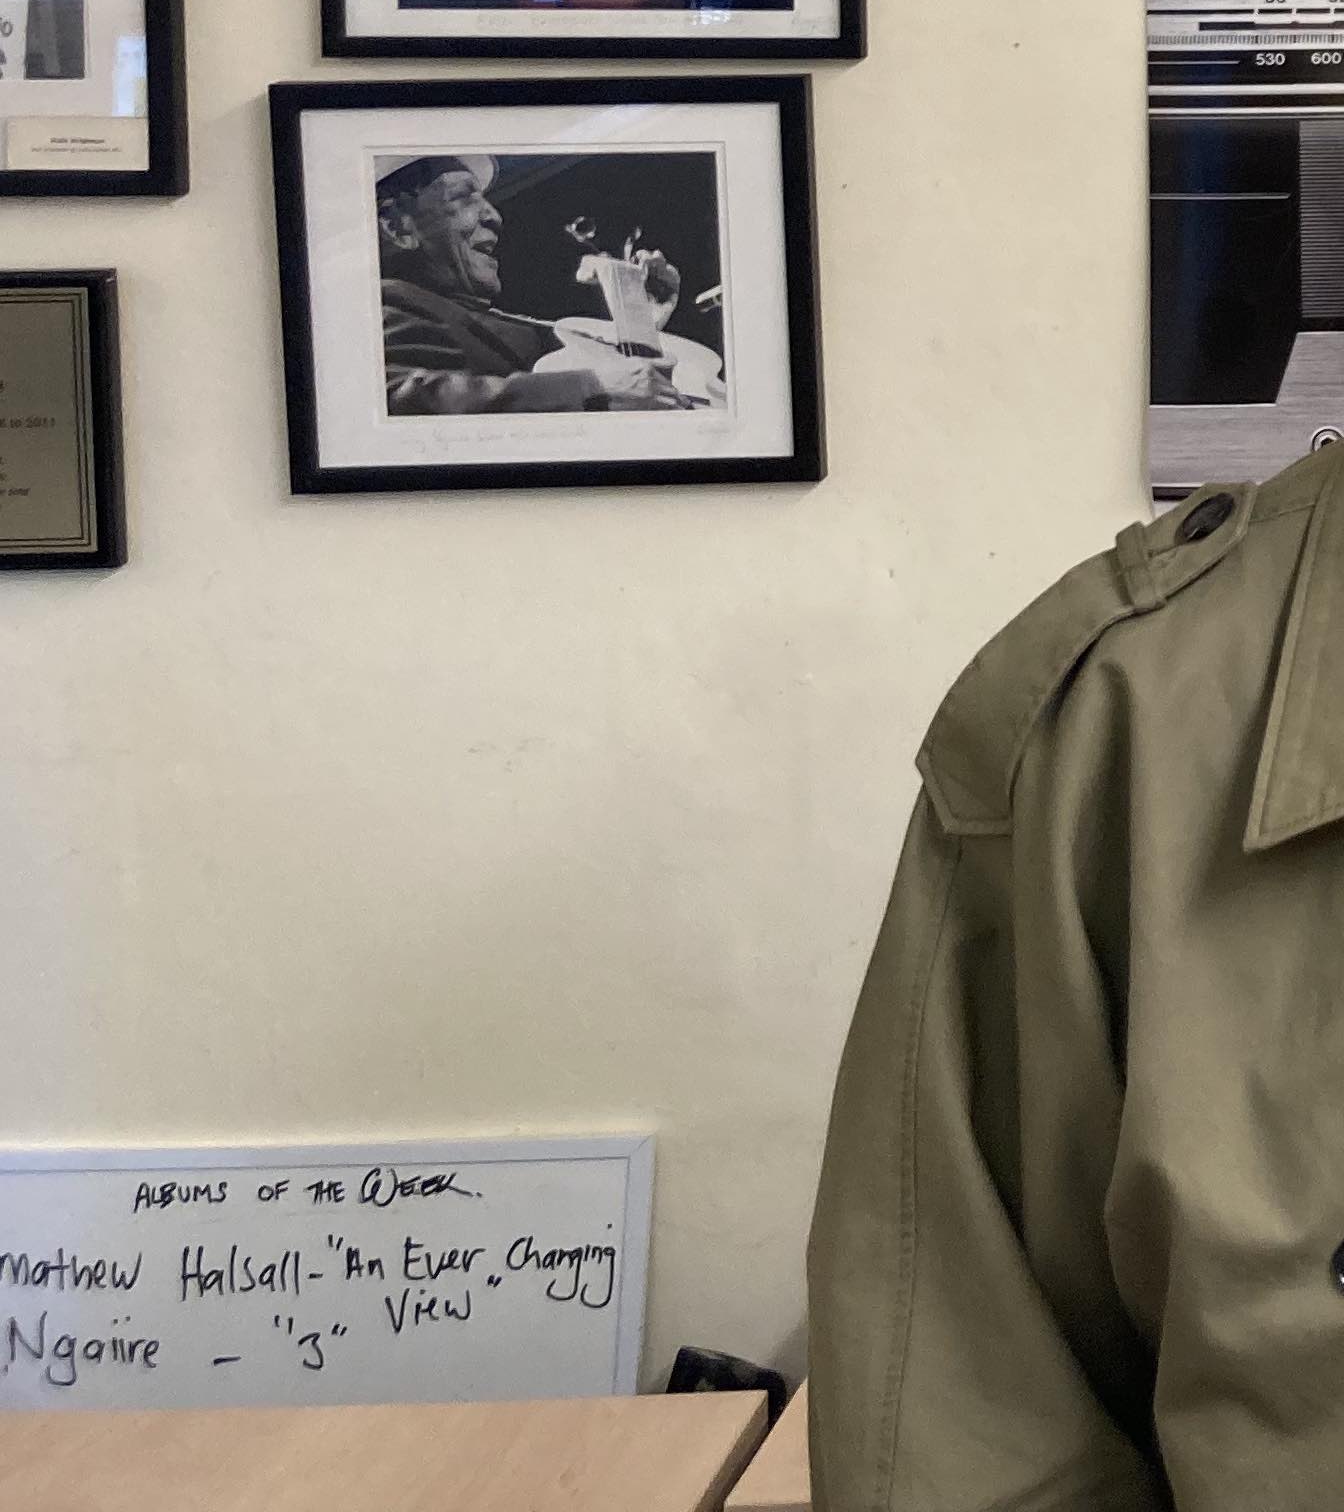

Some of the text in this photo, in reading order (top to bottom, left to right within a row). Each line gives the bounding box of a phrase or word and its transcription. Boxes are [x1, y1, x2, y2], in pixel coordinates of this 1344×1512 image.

[1256, 52, 1286, 66] 530
[1311, 52, 1343, 66] 600
[134, 1181, 227, 1213] ALBUMS
[258, 1179, 291, 1202] OF
[303, 1180, 345, 1205] THE
[404, 1235, 486, 1281] Ever
[506, 1222, 616, 1308] Changing
